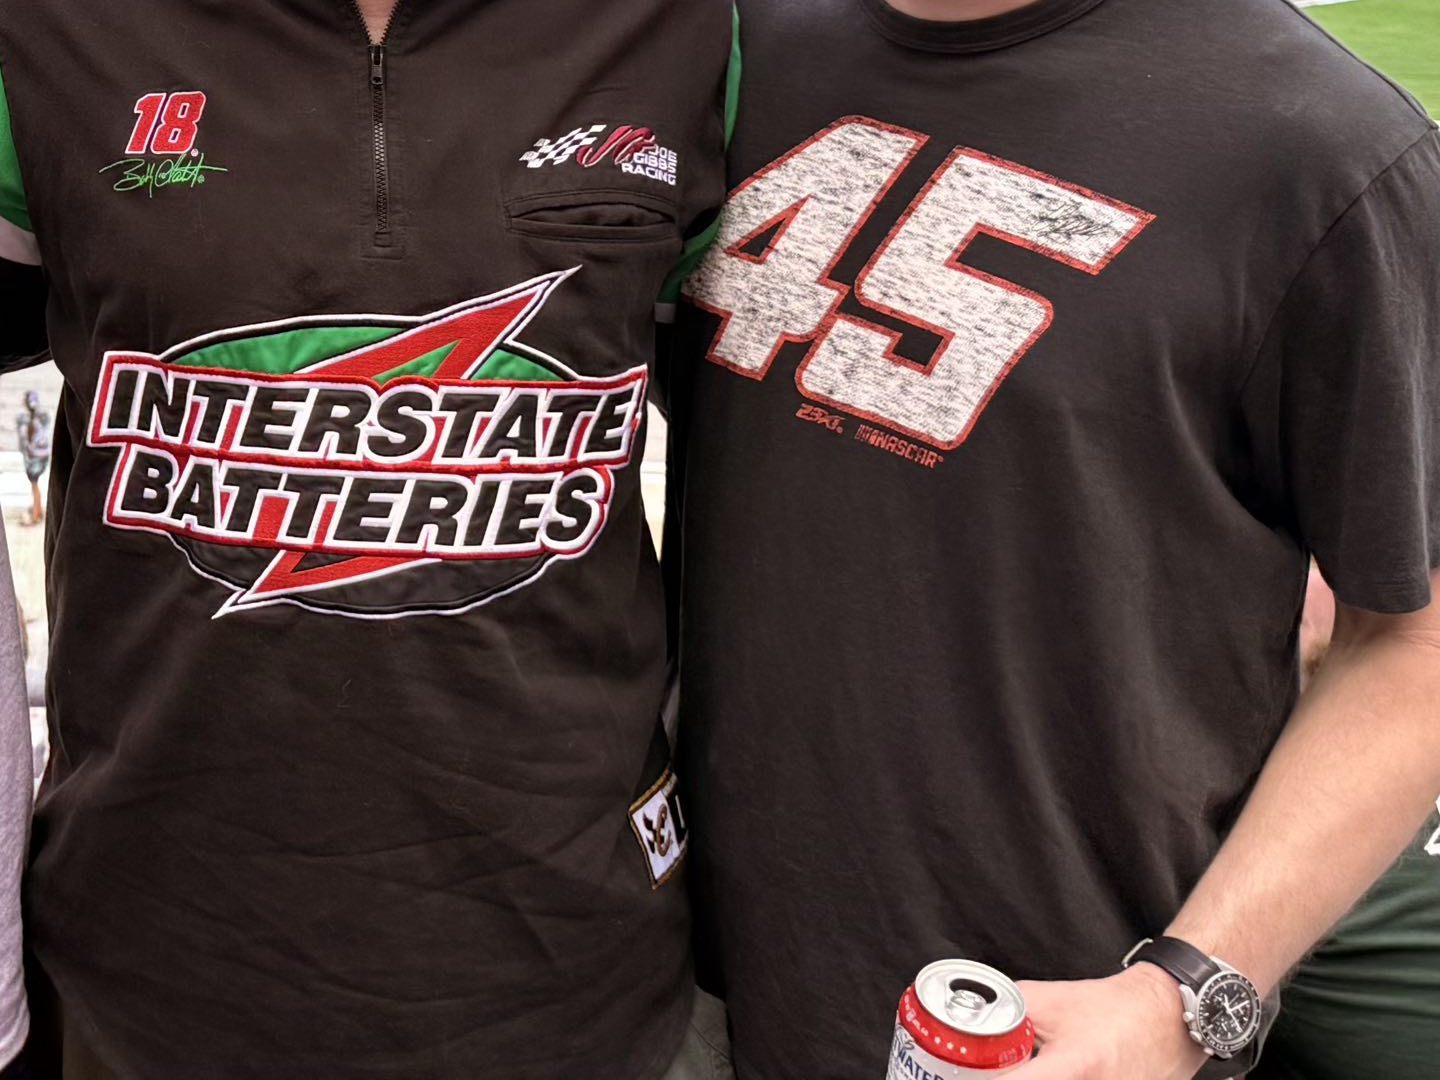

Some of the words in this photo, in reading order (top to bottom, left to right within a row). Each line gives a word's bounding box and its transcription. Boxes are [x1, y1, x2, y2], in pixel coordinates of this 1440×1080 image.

[125, 91, 206, 155] 18
[621, 162, 677, 185] RACING
[633, 153, 678, 174] GIBBS
[649, 144, 678, 162] JOE
[680, 114, 1157, 451] 45
[100, 366, 642, 465] INTERSTATE
[871, 429, 939, 469] NASCAR
[116, 445, 610, 552] BATTERIES
